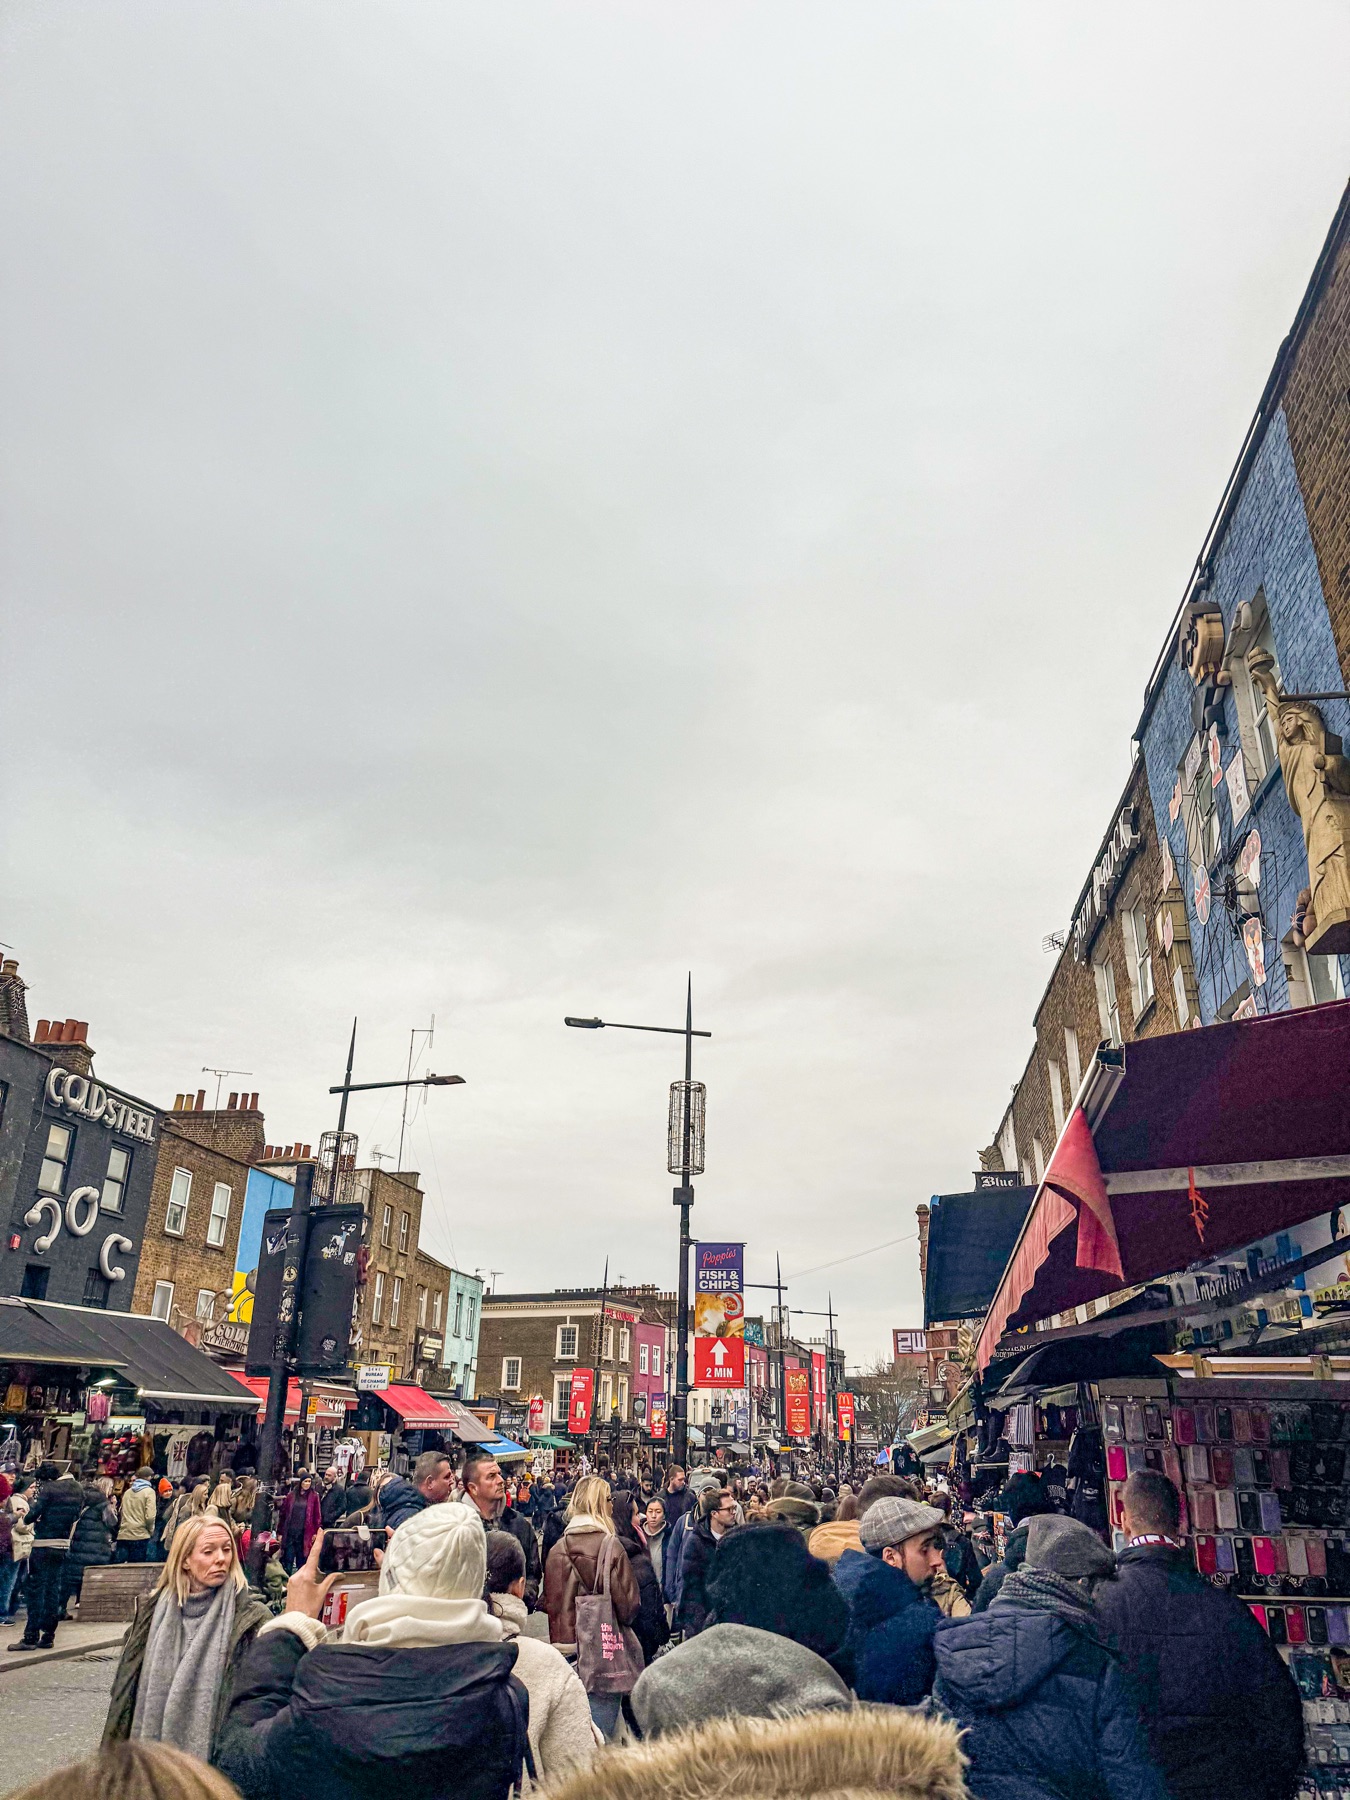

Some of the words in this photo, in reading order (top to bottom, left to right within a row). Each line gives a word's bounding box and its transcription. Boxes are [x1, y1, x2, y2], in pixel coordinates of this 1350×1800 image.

[46, 1067, 107, 1122] COLD
[102, 1099, 155, 1145] STEEL
[981, 1175, 1014, 1188] Blue
[702, 1248, 737, 1268] Poppies
[699, 1270, 727, 1280] FISH
[729, 1270, 739, 1280] &
[699, 1280, 739, 1290] CHIPS
[214, 1336, 245, 1352] PIERCING
[705, 1368, 713, 1378] 2
[714, 1367, 733, 1378] MIN
[531, 1401, 542, 1413] illy
